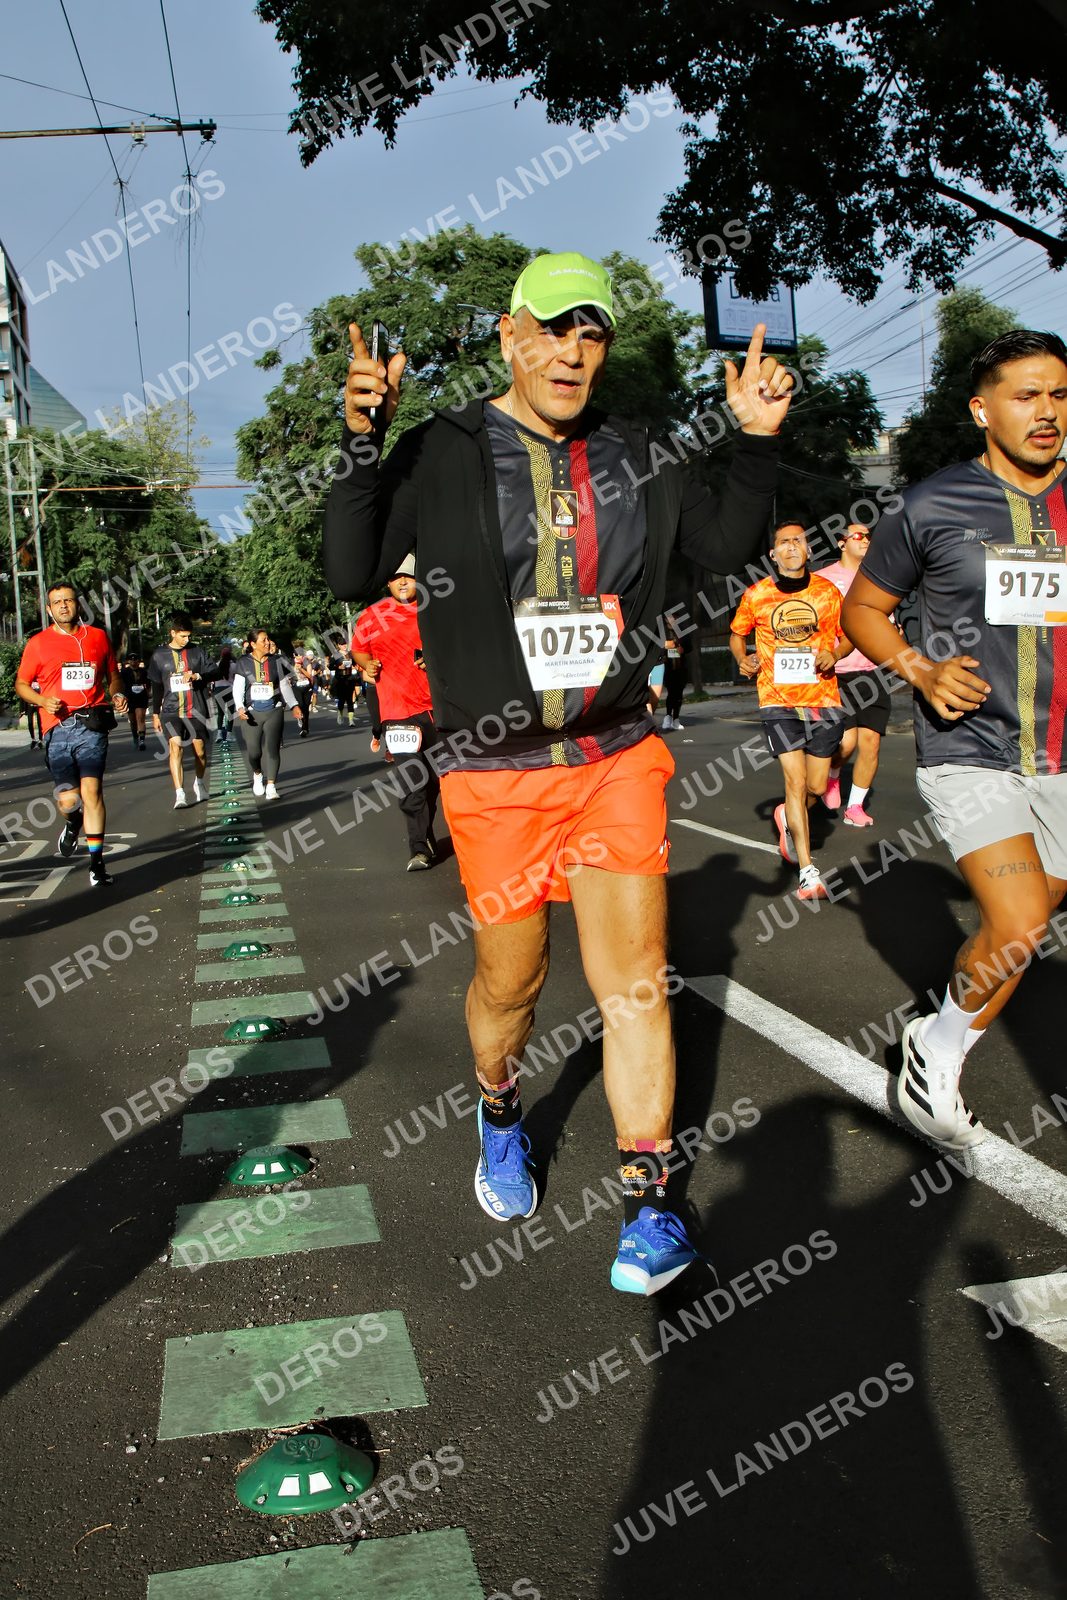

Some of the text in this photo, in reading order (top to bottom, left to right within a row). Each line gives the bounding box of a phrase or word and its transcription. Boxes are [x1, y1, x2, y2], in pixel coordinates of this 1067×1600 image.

[999, 570, 1060, 598] 9175
[522, 624, 612, 657] 10752
[780, 658, 810, 670] 9275
[66, 670, 90, 680] 8236
[388, 734, 418, 744] 10850
